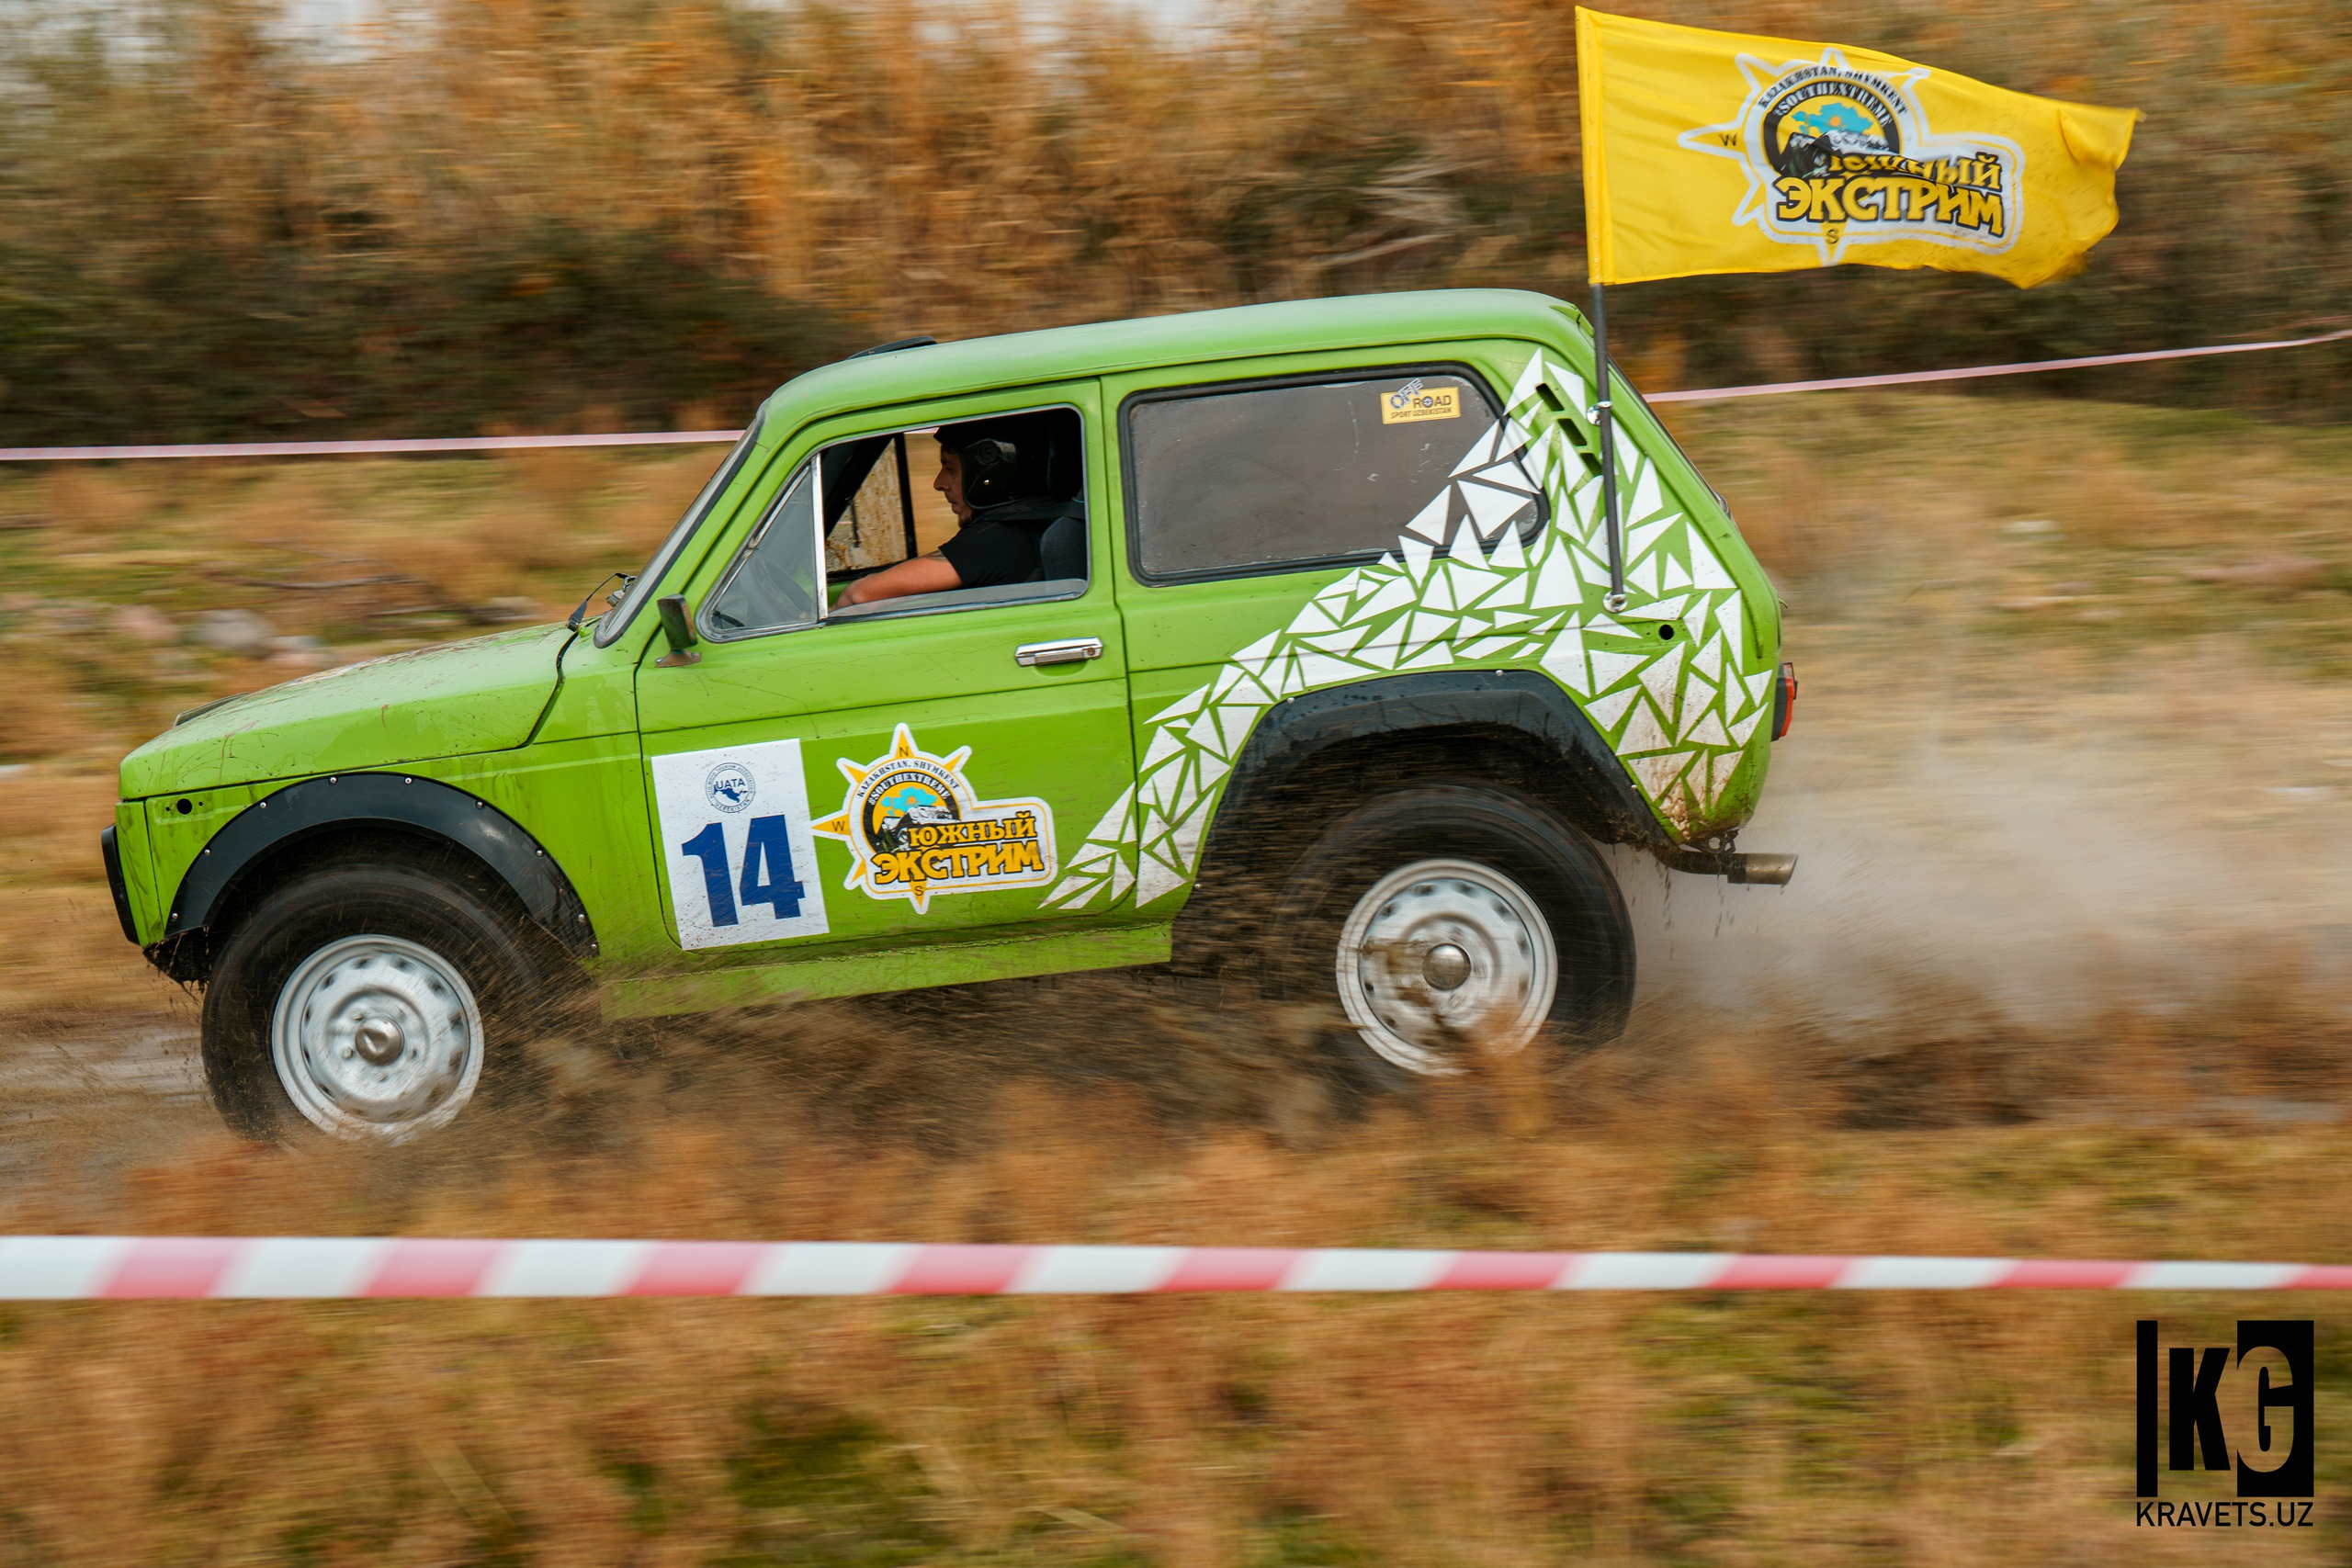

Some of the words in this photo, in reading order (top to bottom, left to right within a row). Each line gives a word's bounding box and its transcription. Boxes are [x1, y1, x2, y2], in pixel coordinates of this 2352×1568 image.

[1720, 133, 1738, 146] W
[1773, 175, 2004, 238] ЭКСТРИМ
[1825, 229, 1838, 244] S
[1391, 378, 1424, 409] OFF
[1413, 395, 1452, 409] ROAD
[1390, 410, 1412, 419] SPORT
[1412, 407, 1452, 417] UZBEKISTAN
[899, 746, 910, 758] N
[716, 778, 745, 789] UATA
[856, 761, 911, 797] KAZAKHSTAN,
[913, 760, 960, 790] SHYMKENT
[867, 773, 952, 806] #SOUTHEXTREME
[831, 820, 846, 832] W
[908, 810, 1037, 848] ЮЖНЫЙ
[872, 840, 1045, 885] ЭКСТРИМ
[681, 814, 806, 927] 14
[914, 886, 924, 897] S
